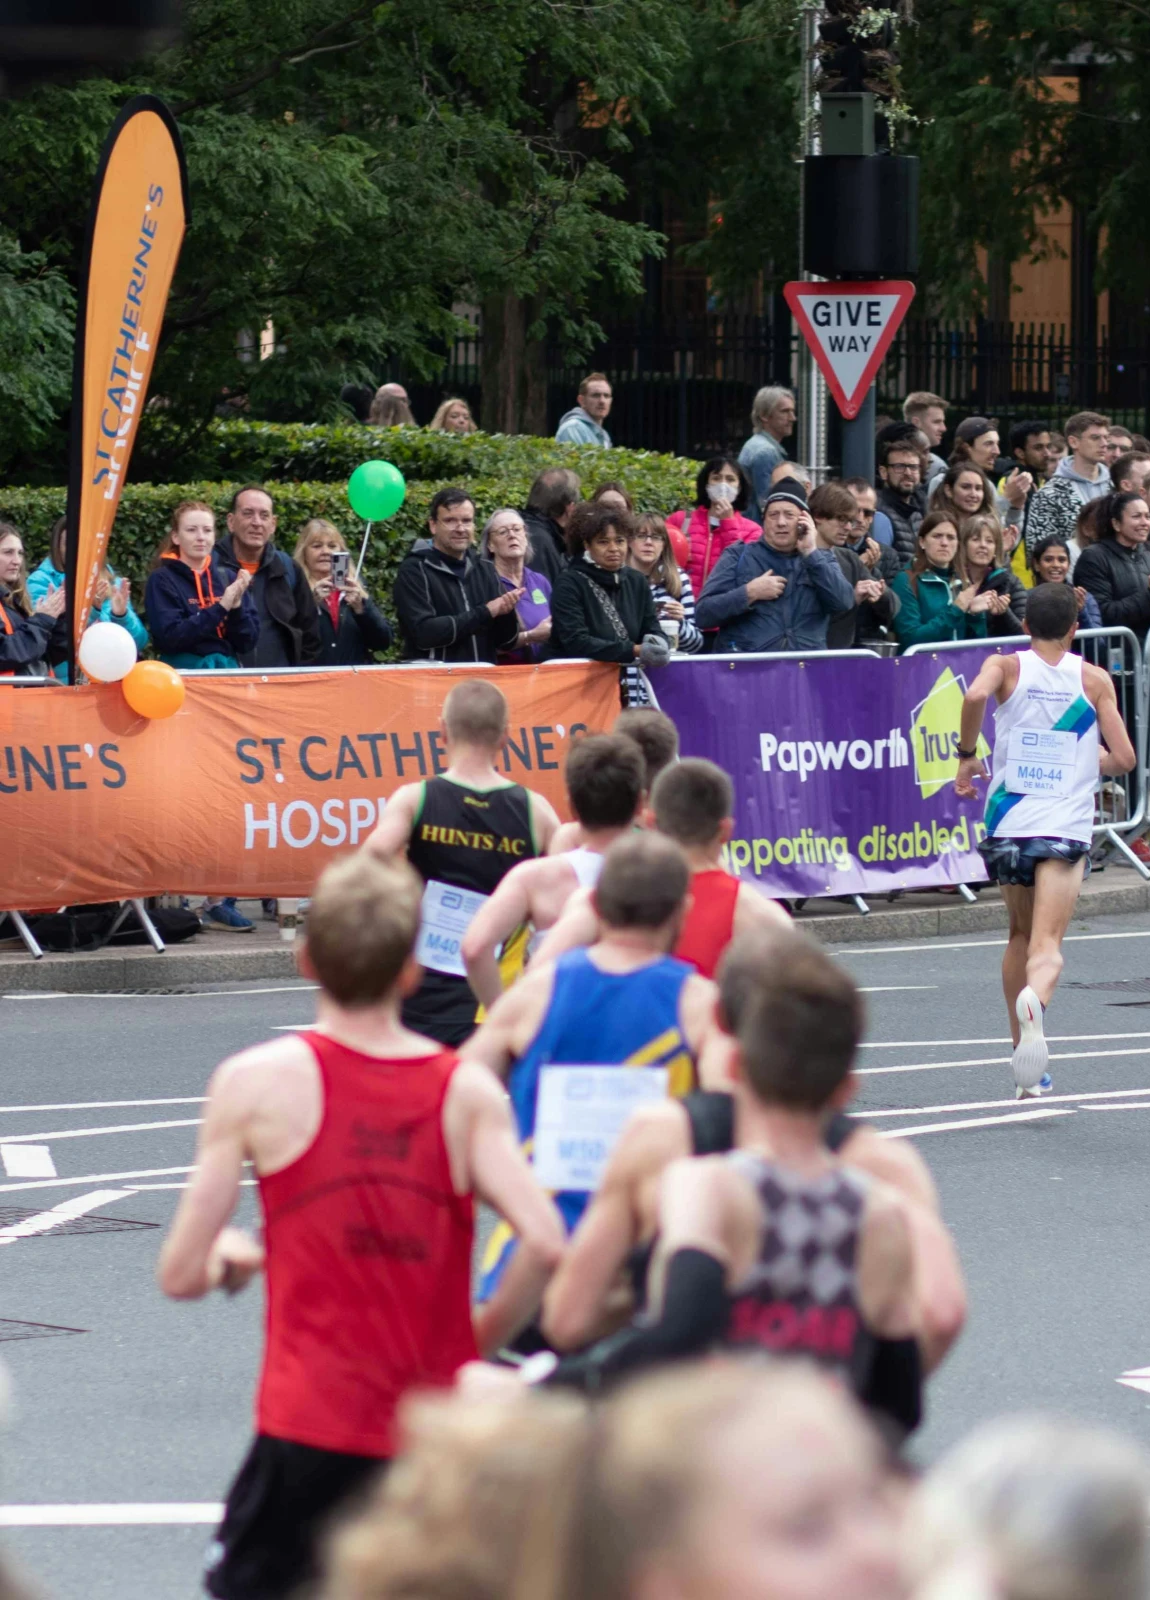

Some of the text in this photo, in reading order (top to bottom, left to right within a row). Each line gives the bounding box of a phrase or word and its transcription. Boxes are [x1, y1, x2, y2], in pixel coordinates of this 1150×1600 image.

[812, 301, 882, 327] GIVE
[828, 336, 871, 352] WAY
[300, 723, 587, 781] CATHENE'
[759, 726, 961, 783] Papworth Trus
[1017, 766, 1063, 782] M40-44
[1023, 780, 1054, 790] DE MATA
[421, 824, 526, 856] HUNTS AC
[858, 816, 970, 862] disabled
